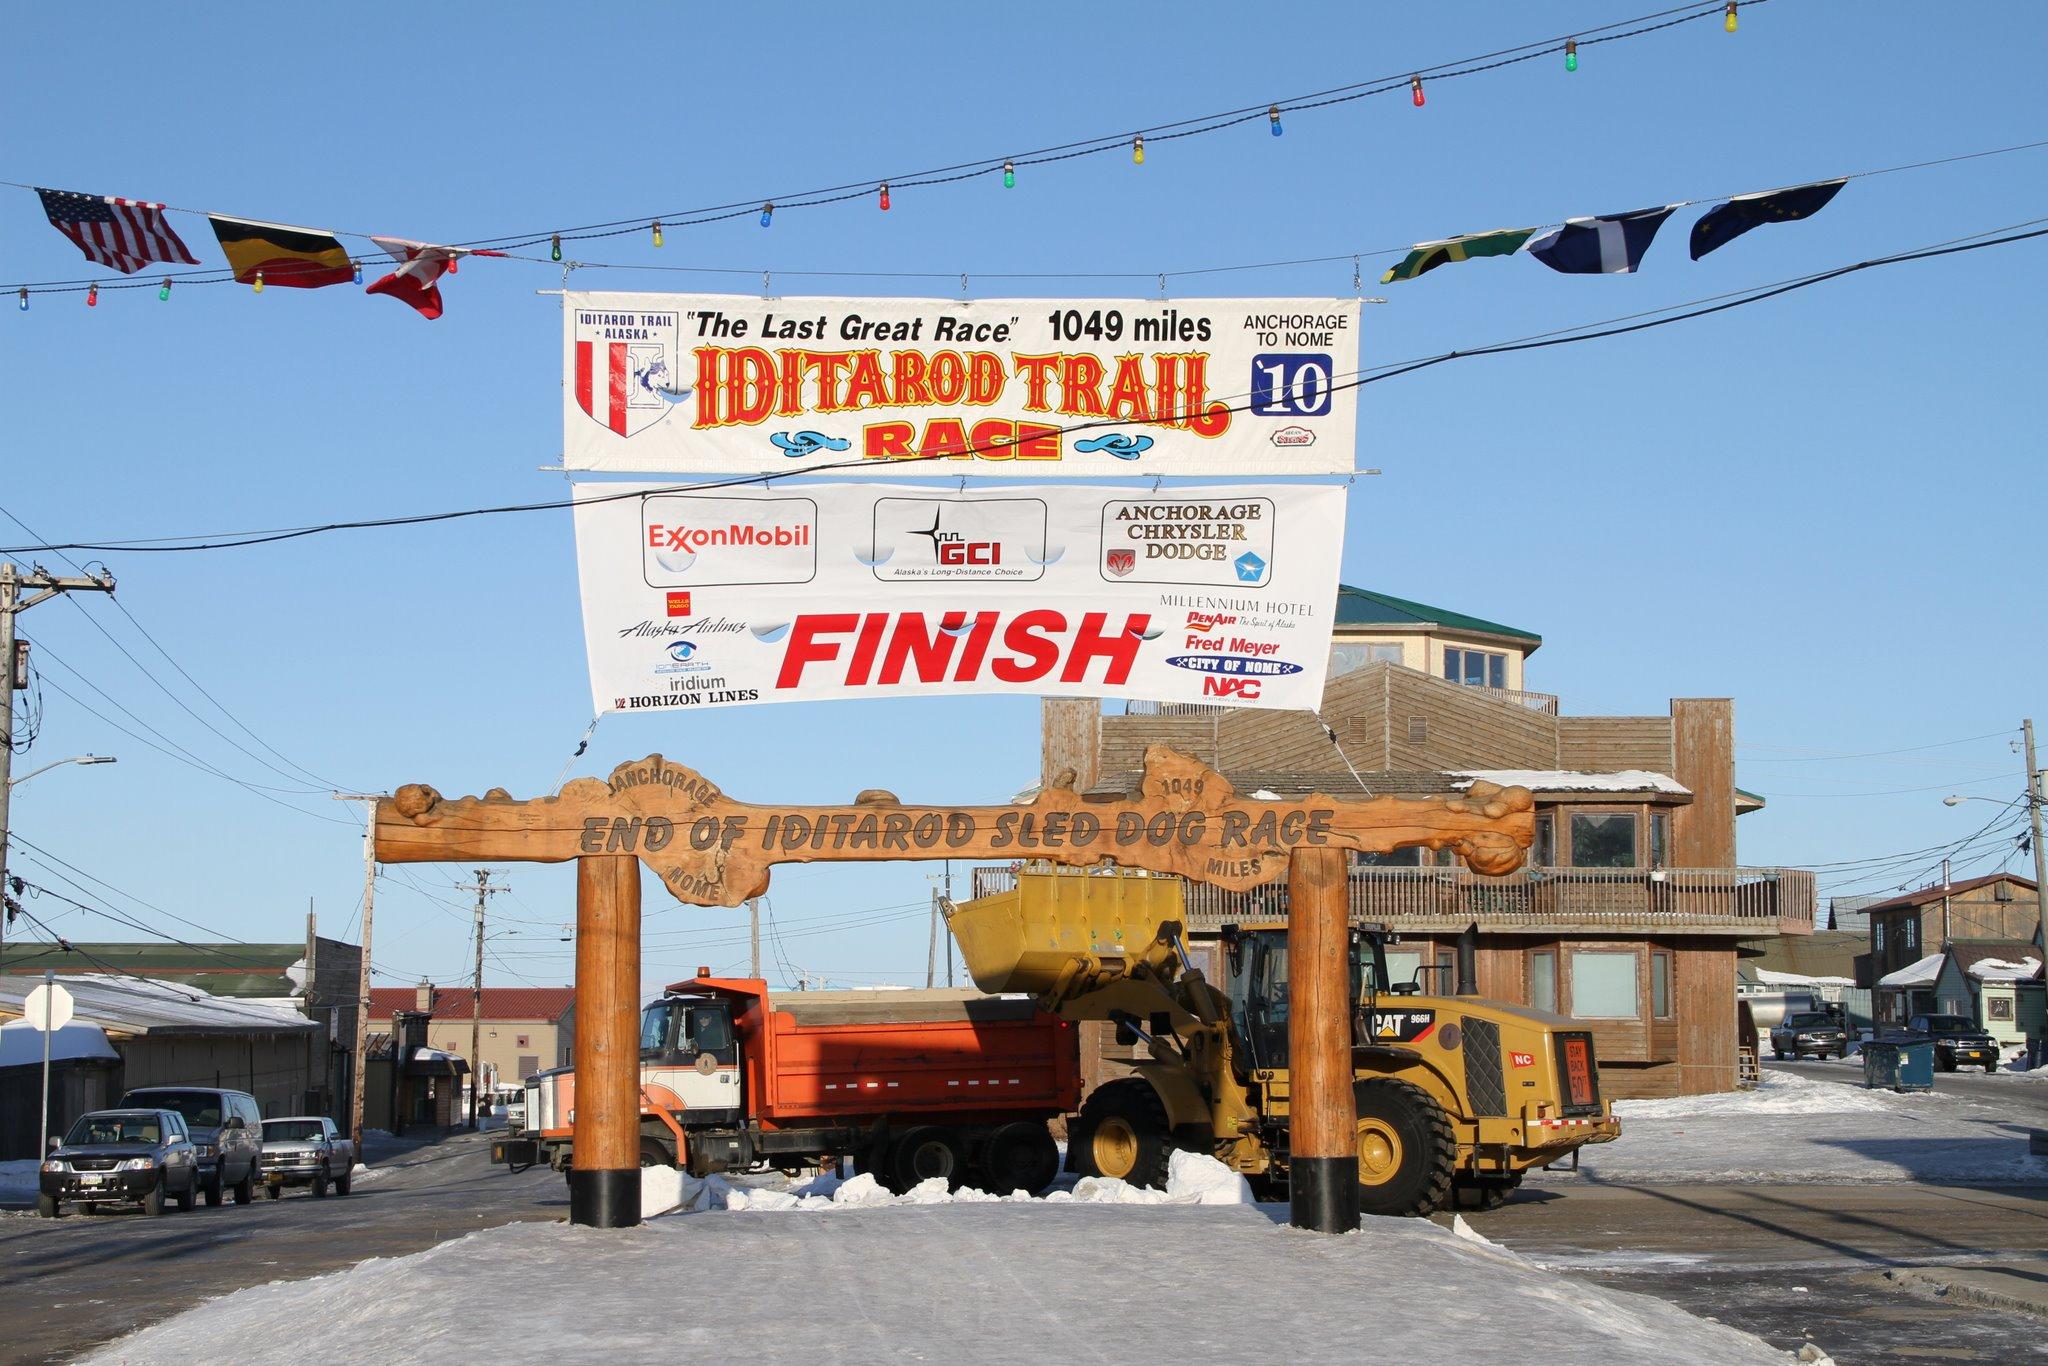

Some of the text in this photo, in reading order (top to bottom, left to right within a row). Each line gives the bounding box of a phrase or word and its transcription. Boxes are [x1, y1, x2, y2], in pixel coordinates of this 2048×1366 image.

[580, 313, 673, 327] IDITAROD TRAIL
[762, 314, 825, 341] Last
[840, 315, 922, 342] Great
[1049, 310, 1123, 341] 1049
[1133, 309, 1212, 342] miles
[1243, 314, 1348, 330] ANCHORAGE
[605, 328, 648, 340] ALASKA
[1256, 332, 1333, 347] TO NOME
[690, 343, 1232, 440] IDITAROD TRAIL
[862, 418, 1063, 461] RACE
[1116, 504, 1261, 521] ANCHORAGE
[649, 524, 809, 554] ExxonMobil
[1127, 524, 1247, 541] CHRYSLER
[940, 542, 1000, 565] GCI
[1146, 543, 1227, 561] DODGE
[894, 568, 1023, 577] Alaska's Long-Distance Choice
[1160, 595, 1314, 616] MILLENNIUM HOTEL
[618, 617, 747, 638] Alaska Airlines
[1240, 616, 1249, 625] The
[1251, 617, 1267, 629] Spirit
[1268, 620, 1274, 631] of
[1275, 619, 1296, 629] Alaska
[775, 610, 1151, 689] FINISH
[1185, 635, 1280, 657] Fred Meyer
[1188, 657, 1281, 674] CITY OF NOME
[670, 675, 726, 691] iridium
[1203, 676, 1261, 699] NAC
[630, 689, 759, 708] HORIZON LINES
[615, 768, 721, 808] ANCHORAGE
[1161, 778, 1204, 796] 1049
[580, 809, 1334, 852] END OF IDITAROD SLED DOG RACE
[1206, 858, 1262, 878] MILES
[668, 866, 720, 901] NOME
[1372, 1014, 1430, 1037] CAT 966H
[1514, 1055, 1532, 1065] NC
[1568, 1044, 1583, 1058] STAY
[1569, 1059, 1585, 1073] BACK
